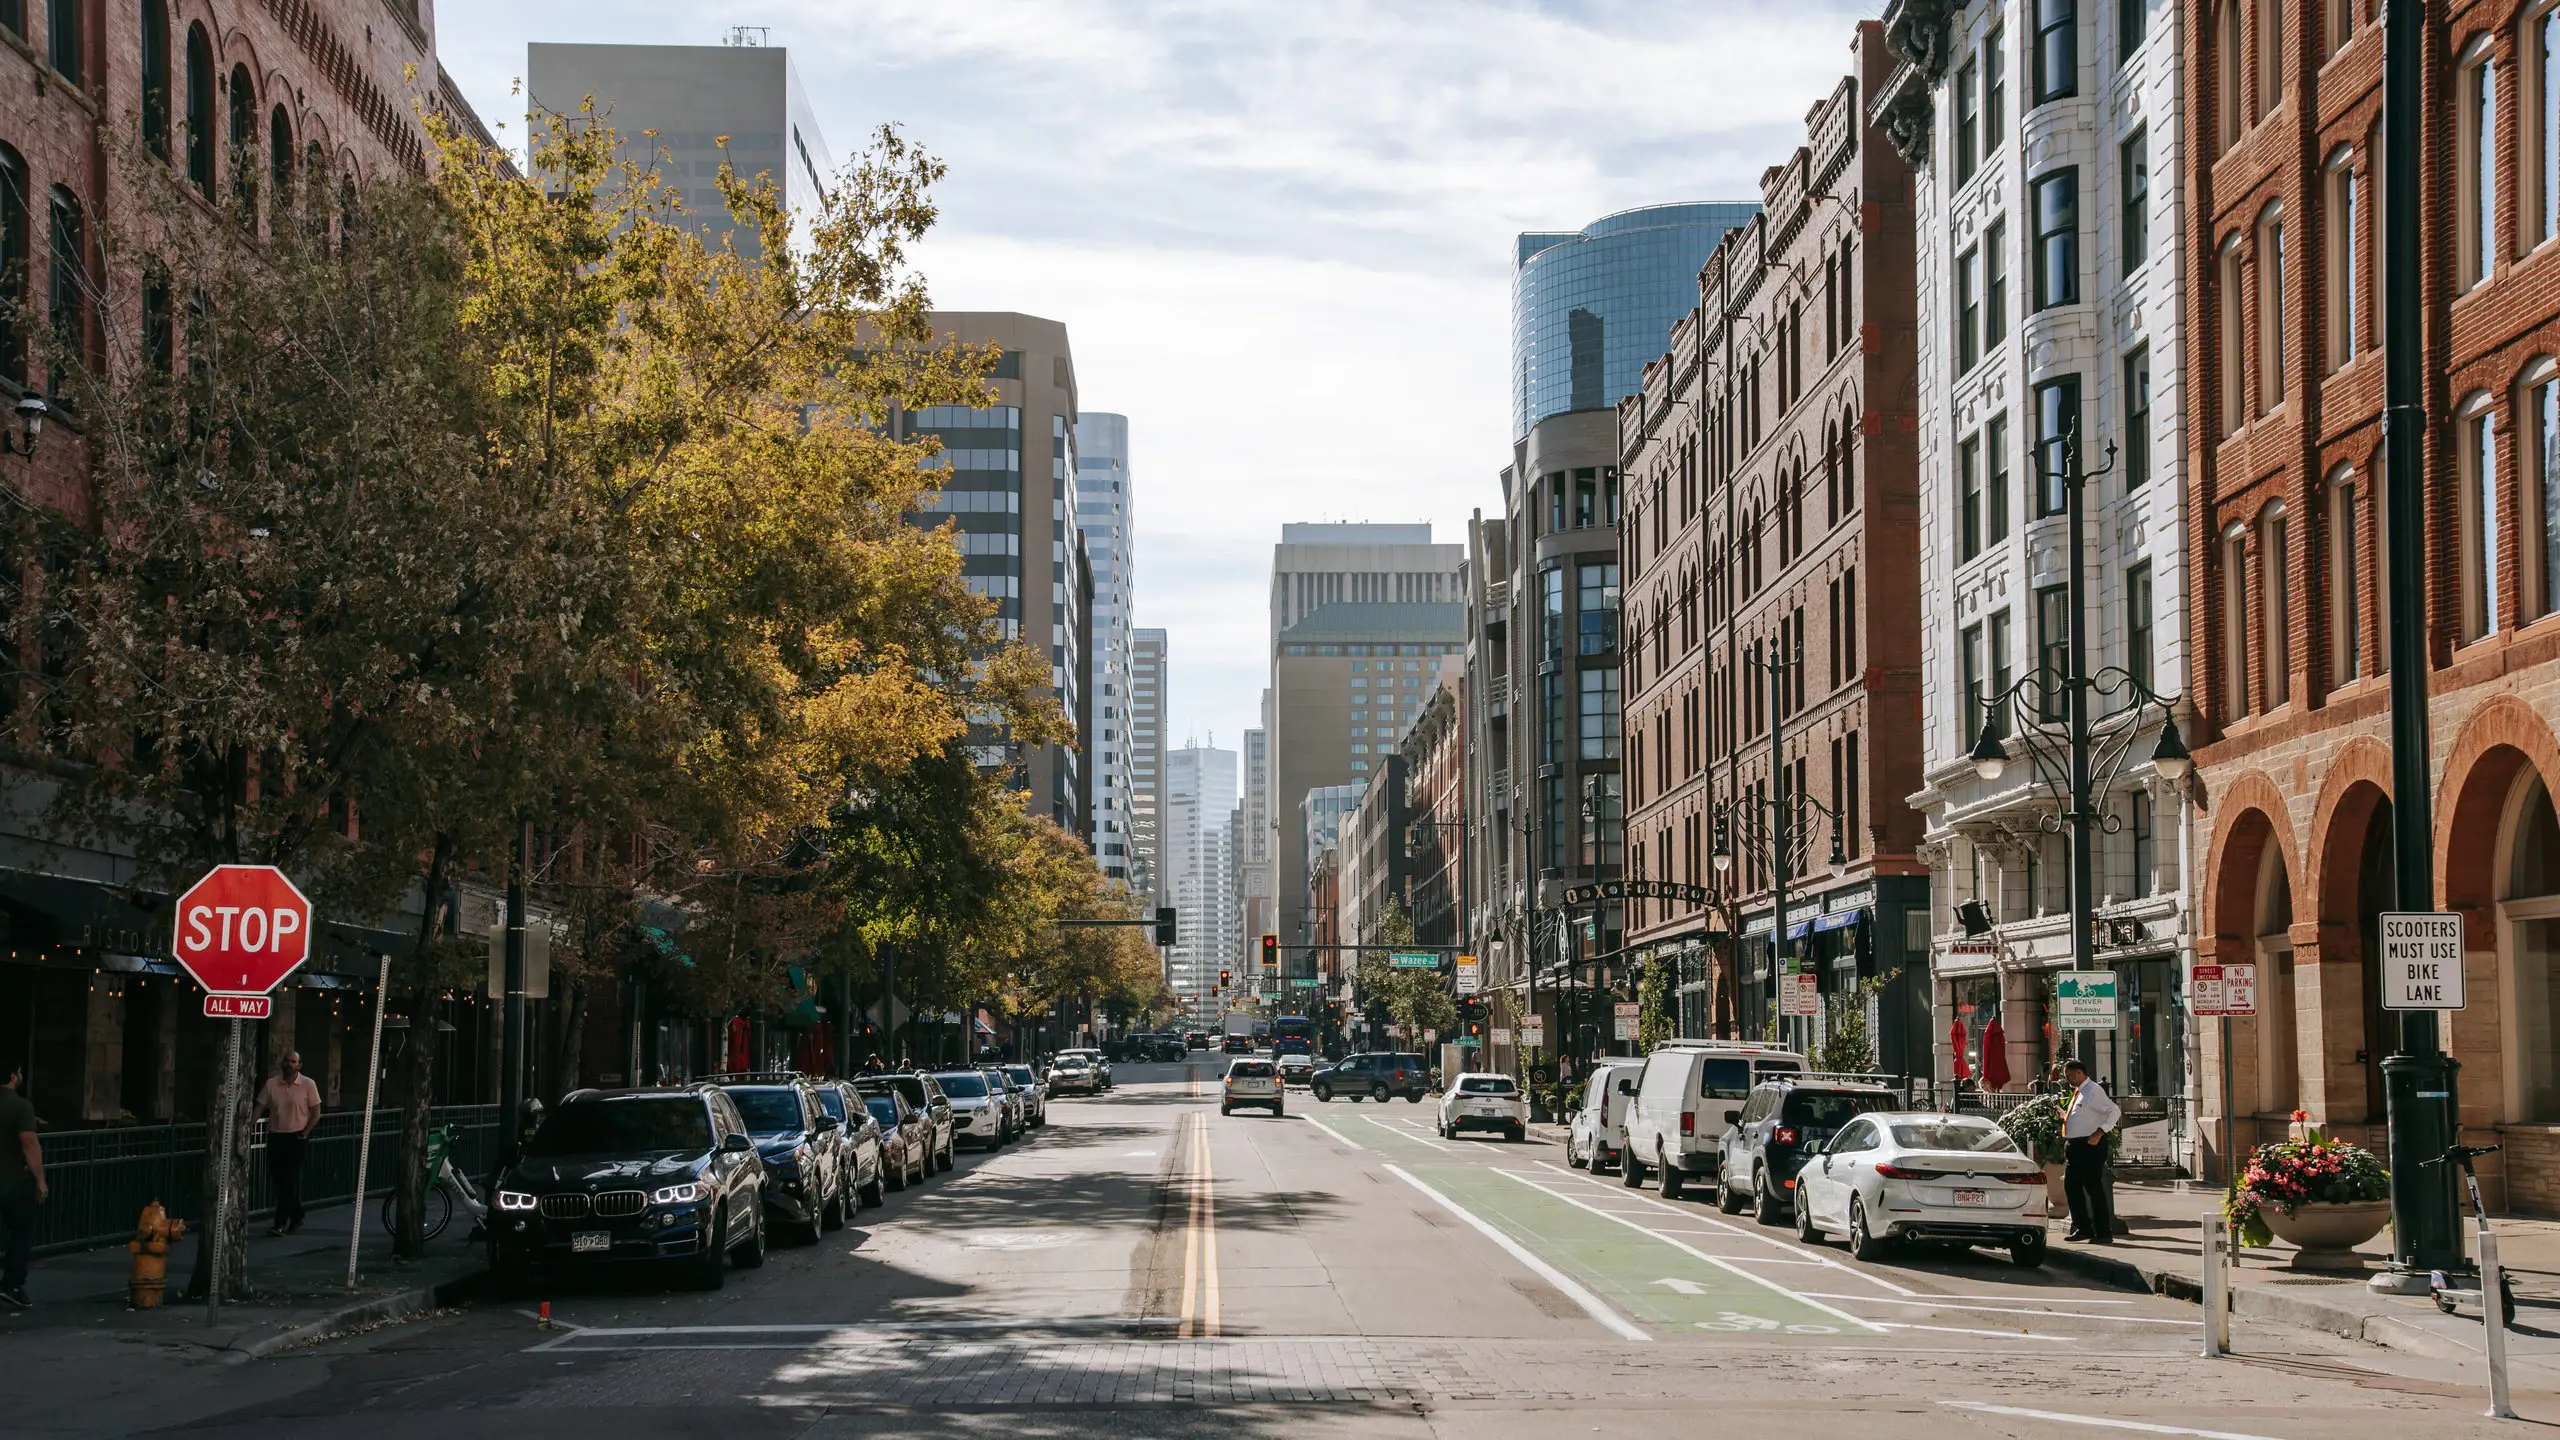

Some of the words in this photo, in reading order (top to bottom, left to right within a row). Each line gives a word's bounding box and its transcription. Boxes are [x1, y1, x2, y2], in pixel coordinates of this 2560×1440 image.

[1566, 882, 1714, 904] OXFORD
[184, 905, 300, 952] STOP
[2387, 921, 2456, 937] SCOOTERS
[1952, 945, 1998, 954] AMANTE
[2389, 943, 2424, 958] MUST
[2430, 943, 2456, 958] USE
[1400, 956, 1427, 965] Wazee
[2235, 967, 2245, 977] NO
[2407, 964, 2439, 979] BIKE
[2227, 977, 2253, 988] PARKING
[2406, 985, 2442, 1000] LANE
[210, 1000, 232, 1012] ALL
[240, 1001, 263, 1013] WAY
